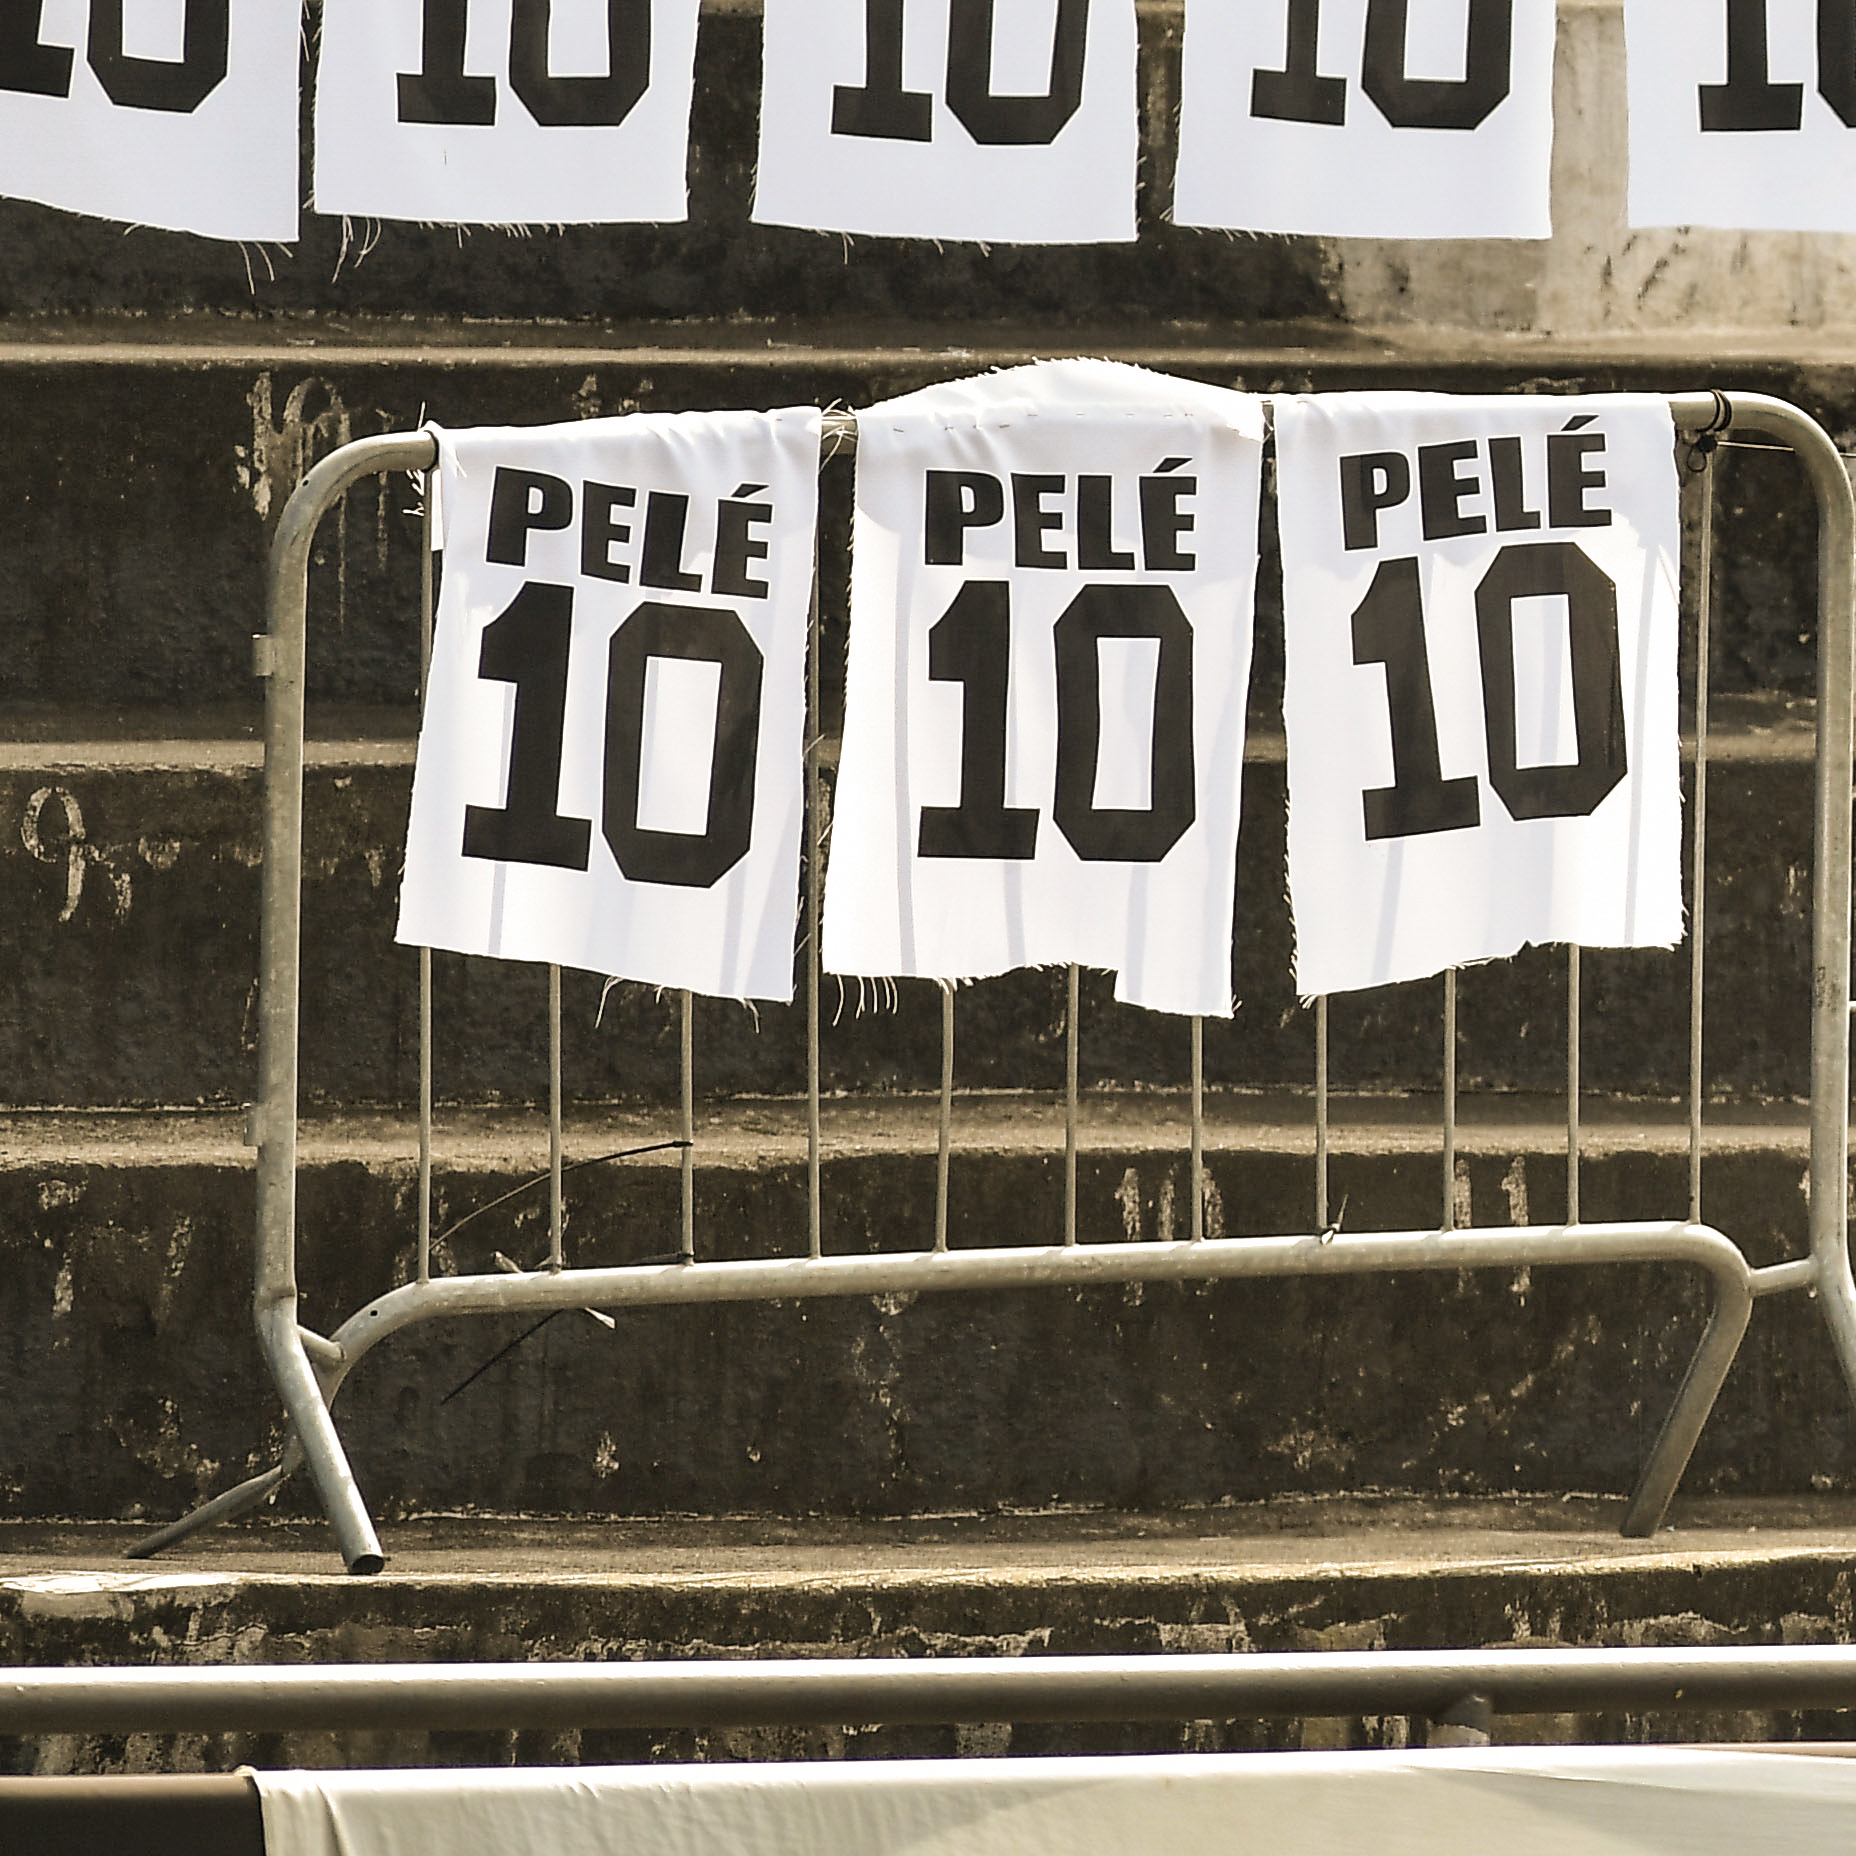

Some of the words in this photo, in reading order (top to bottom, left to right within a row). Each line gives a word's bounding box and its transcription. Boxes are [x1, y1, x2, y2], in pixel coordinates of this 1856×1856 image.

[484, 465, 774, 601] PELÉ
[923, 456, 1198, 573] PELÉ
[1338, 413, 1613, 552] PELÉ
[460, 579, 765, 890] 10
[916, 579, 1197, 864] 10
[1348, 540, 1629, 842] 10
